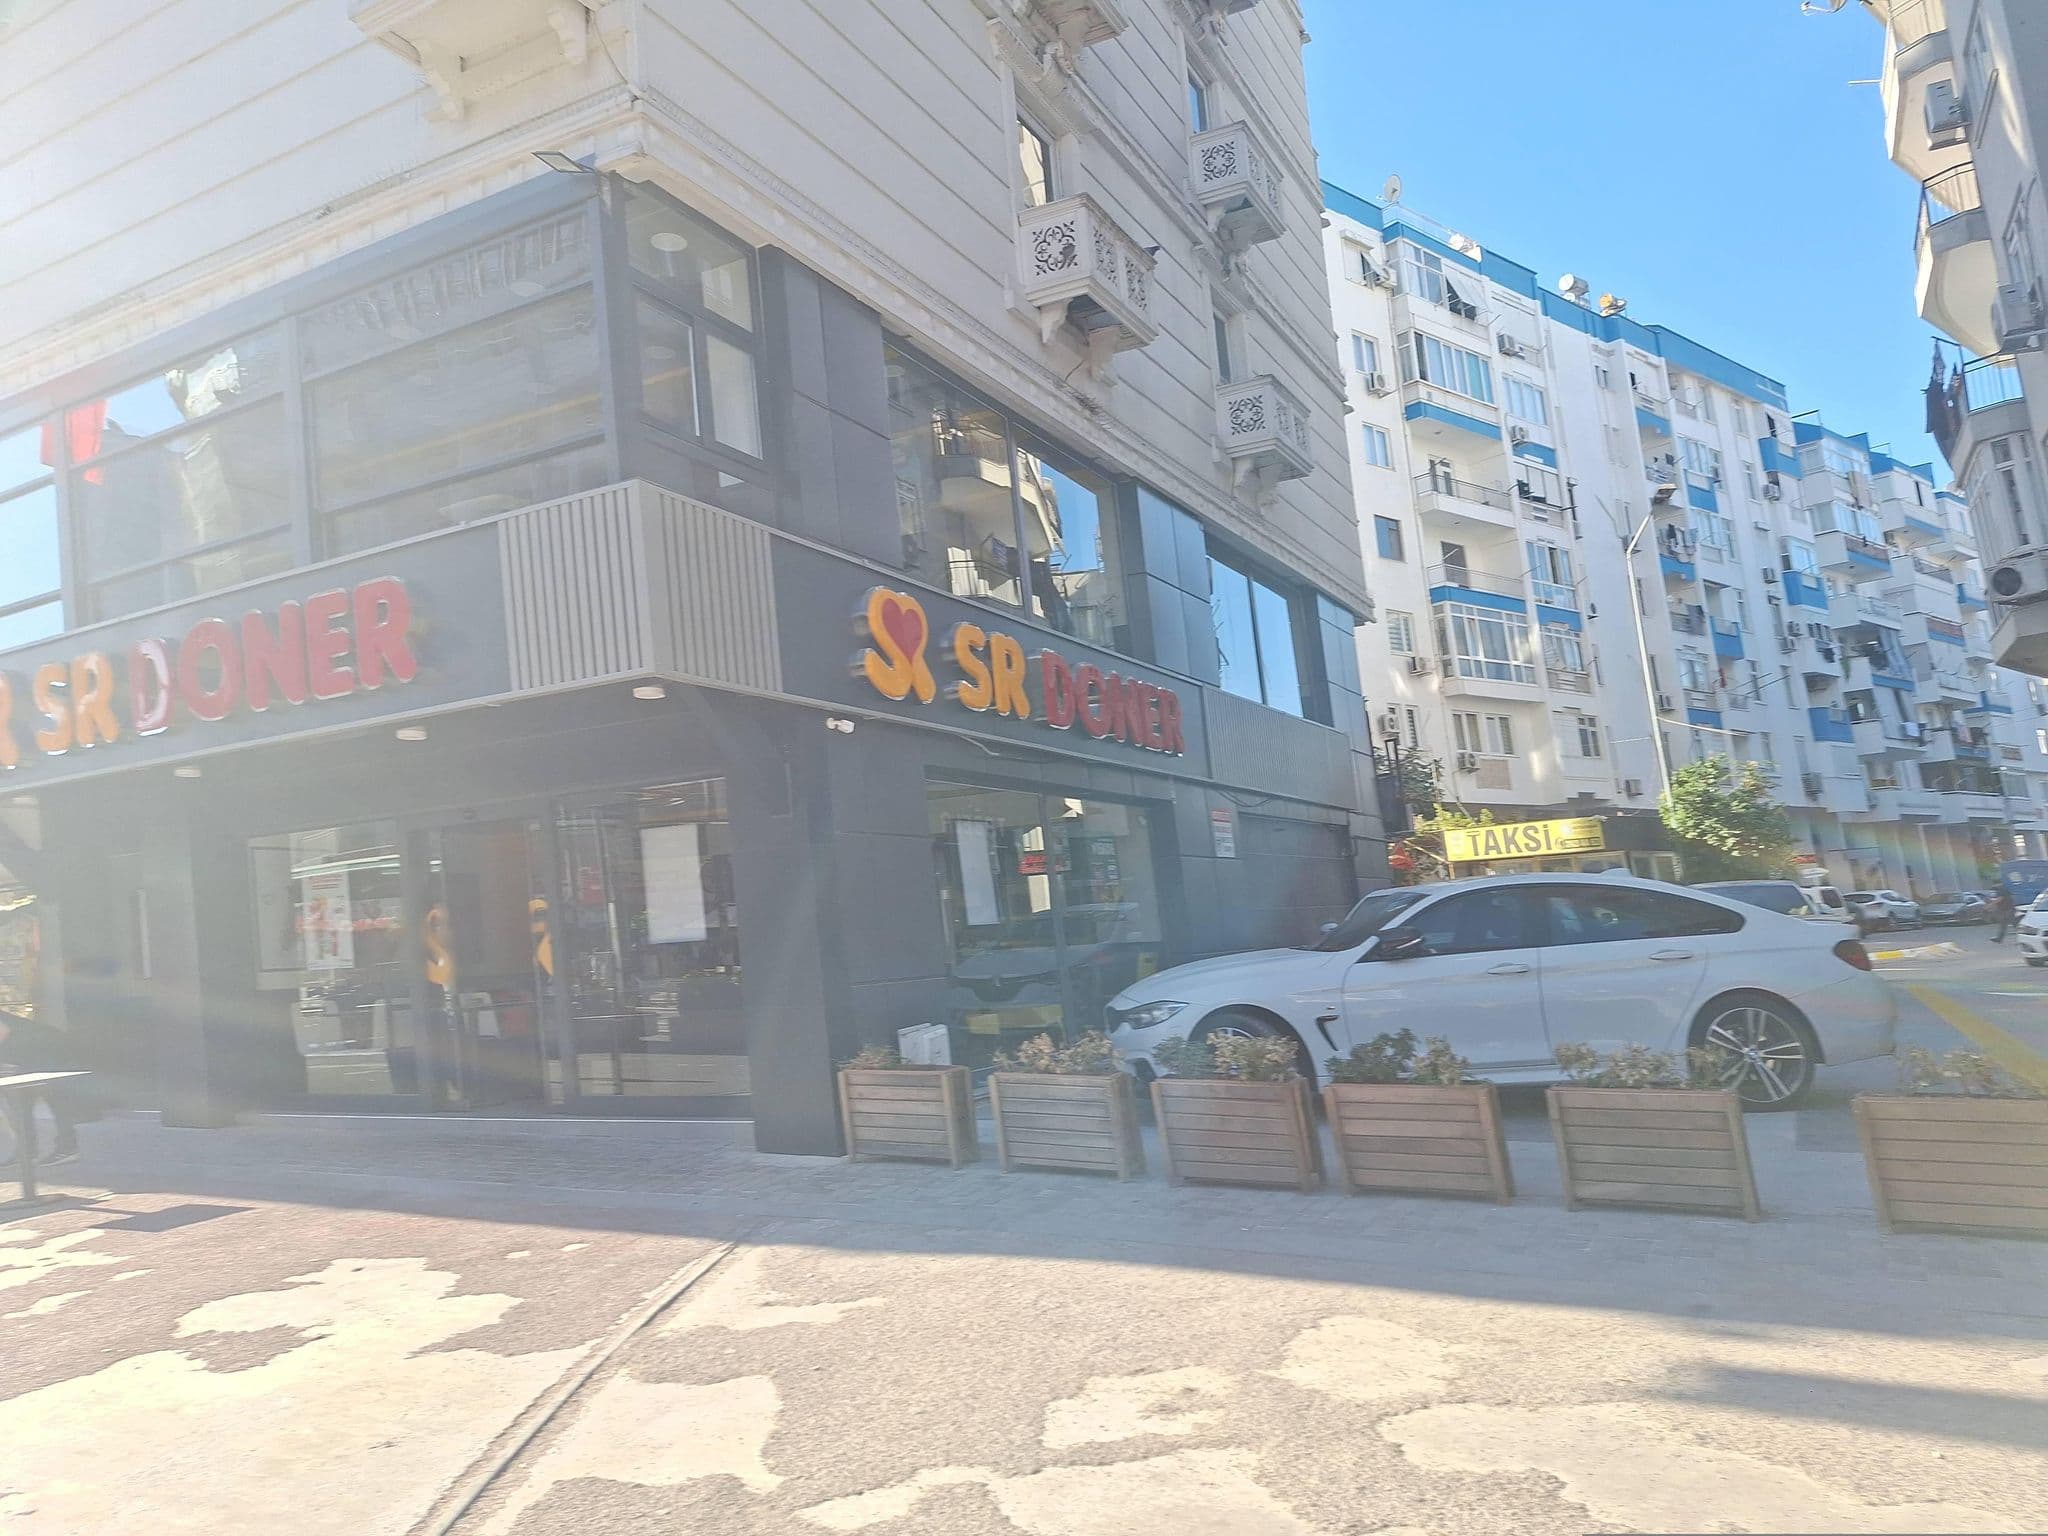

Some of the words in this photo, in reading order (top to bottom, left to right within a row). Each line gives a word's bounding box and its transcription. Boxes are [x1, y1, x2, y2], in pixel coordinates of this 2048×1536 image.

[34, 651, 119, 755] SR
[129, 575, 417, 736] DONER
[954, 622, 1031, 719] SR
[1041, 648, 1185, 757] DONER
